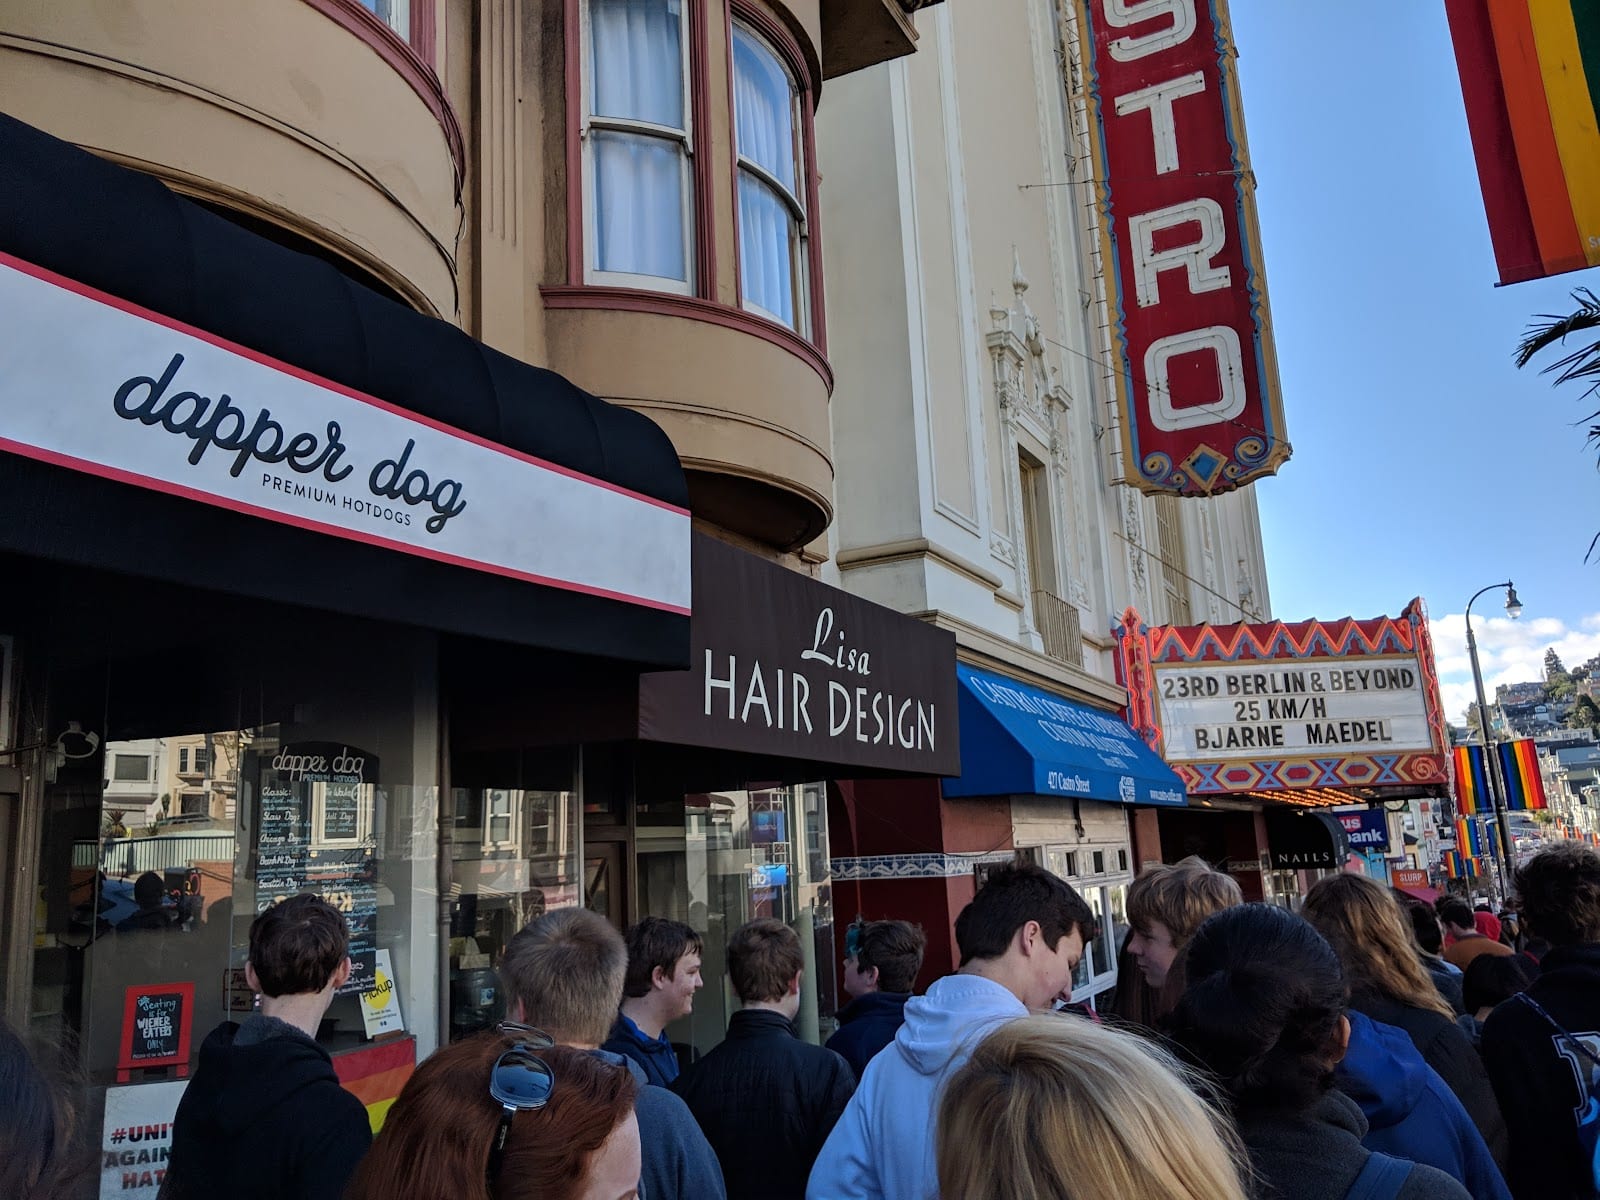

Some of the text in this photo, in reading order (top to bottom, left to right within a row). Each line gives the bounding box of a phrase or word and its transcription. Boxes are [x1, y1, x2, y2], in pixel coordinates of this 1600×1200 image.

[113, 353, 467, 534] dapper dog
[262, 473, 412, 527] PREMIUM HOTDOGS
[801, 607, 872, 676] Lisa
[1163, 668, 1415, 699] 23RD BERLIN & BEYOND
[704, 648, 935, 752] HAIR DESIGN
[1234, 697, 1328, 722] 25 KM/H
[1195, 720, 1392, 750] BJARNE MAEDEL
[272, 745, 329, 782] dapper
[1278, 851, 1330, 863] NAILS
[1399, 872, 1422, 882] SLURP
[137, 1016, 171, 1029] WIENER
